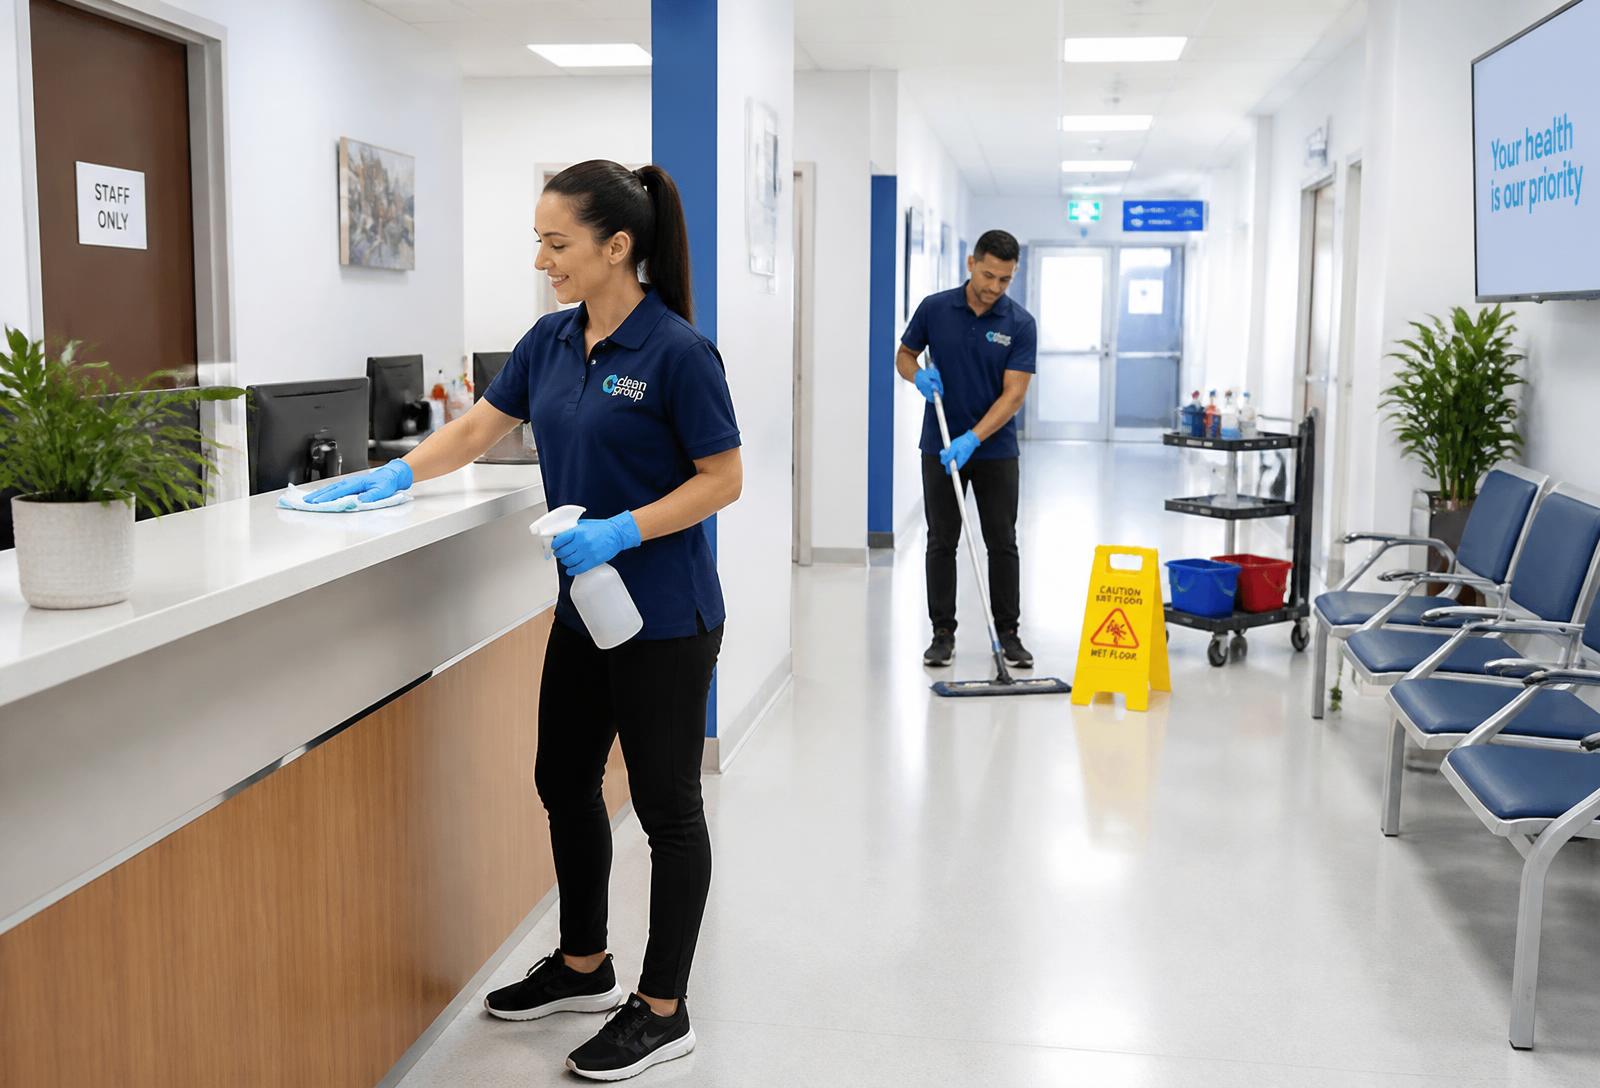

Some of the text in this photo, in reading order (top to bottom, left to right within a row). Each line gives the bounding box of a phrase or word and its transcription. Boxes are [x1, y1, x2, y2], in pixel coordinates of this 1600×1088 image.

[1491, 112, 1573, 171] Your health
[94, 183, 130, 205] STAFF
[1491, 159, 1584, 215] is our priority
[97, 210, 129, 231] ONLY
[617, 375, 647, 391] clean
[612, 386, 644, 402] group
[1100, 585, 1141, 596] CAUTION
